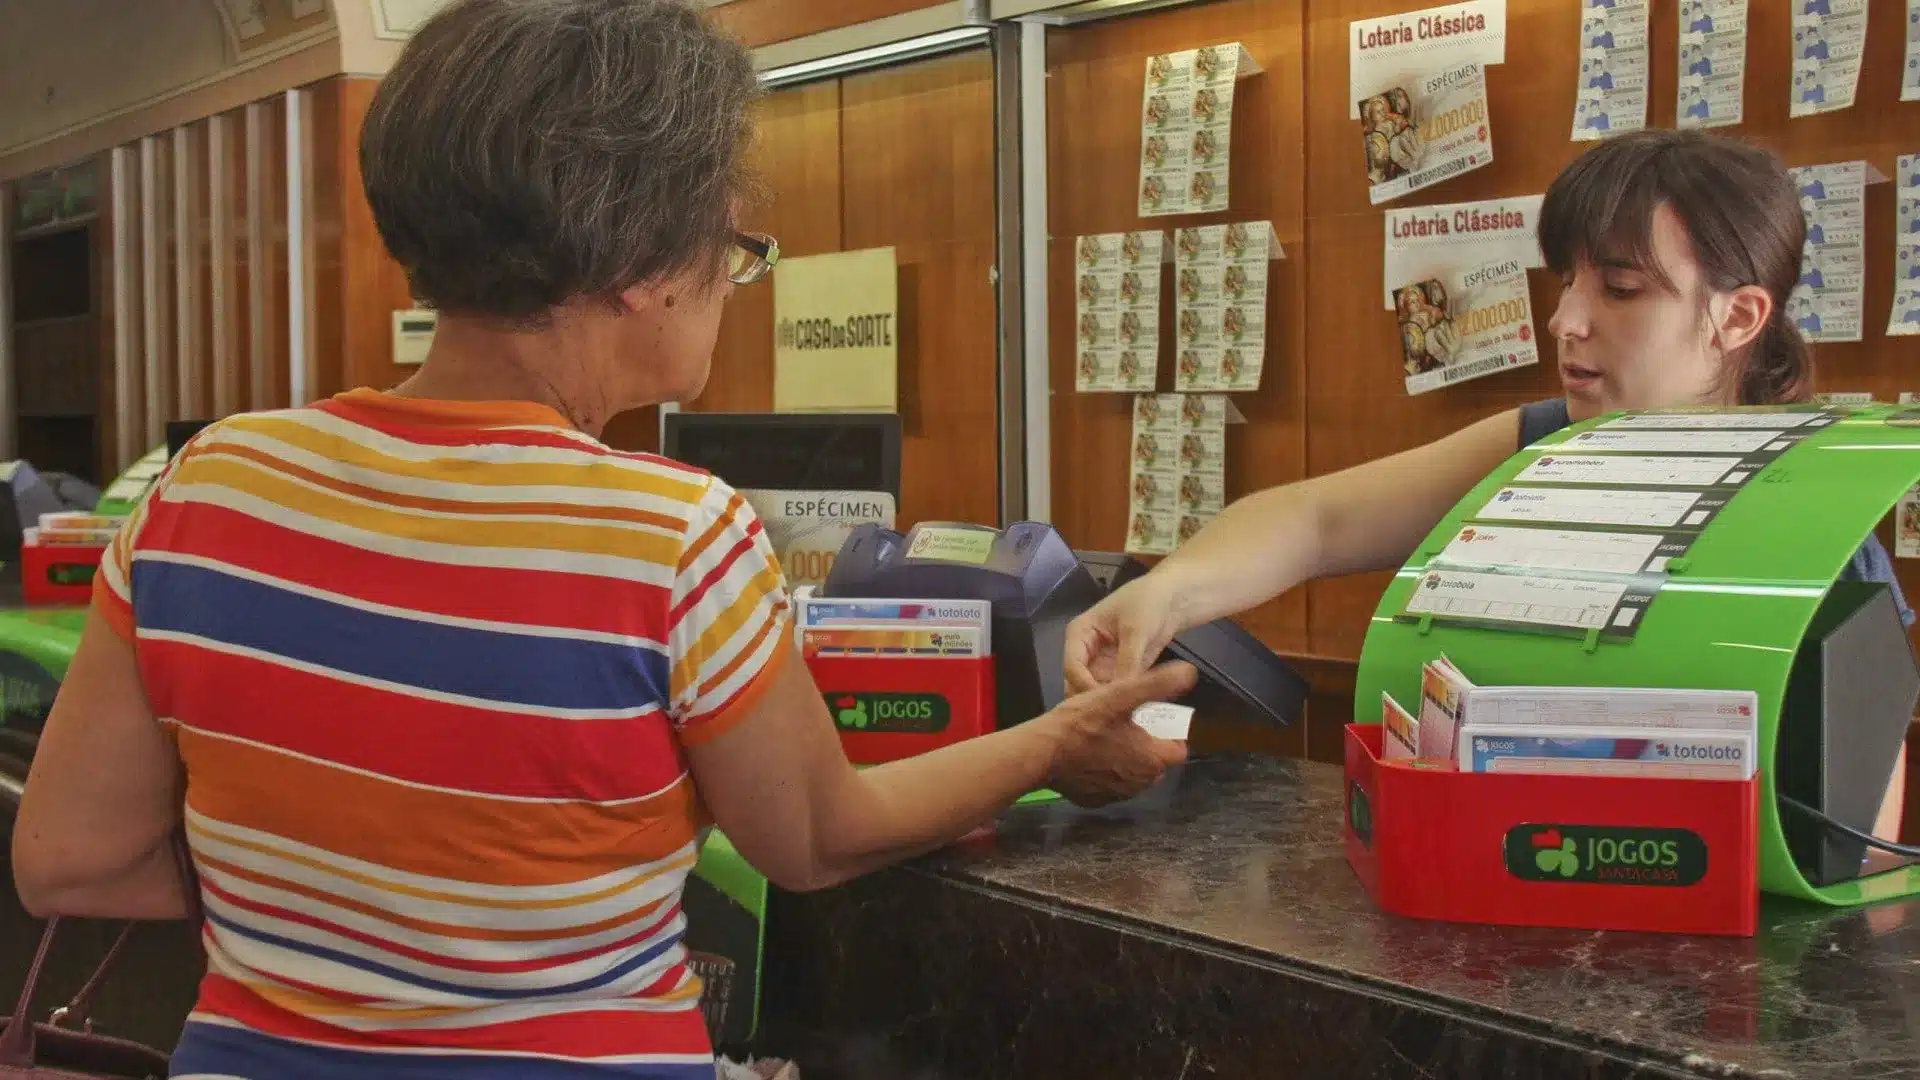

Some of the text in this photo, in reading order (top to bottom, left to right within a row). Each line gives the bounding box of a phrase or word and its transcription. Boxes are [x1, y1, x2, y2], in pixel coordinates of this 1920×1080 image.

[1359, 10, 1486, 50] Lotaria Clássica
[1426, 62, 1479, 93] ESPÉCIMEN
[1393, 206, 1525, 239] Lotaria Clássica
[1463, 260, 1519, 287] ESPÉCIMEN
[796, 317, 831, 350] CASA
[847, 313, 892, 348] SORTE
[785, 498, 883, 518] ESPÉCIMEN
[1623, 594, 1652, 603] JACKPOT
[938, 606, 981, 619] totoloto
[944, 633, 961, 641] euro
[873, 700, 933, 725] JOGOS
[1674, 743, 1741, 761] totoloto
[1586, 837, 1679, 871] JOGOS
